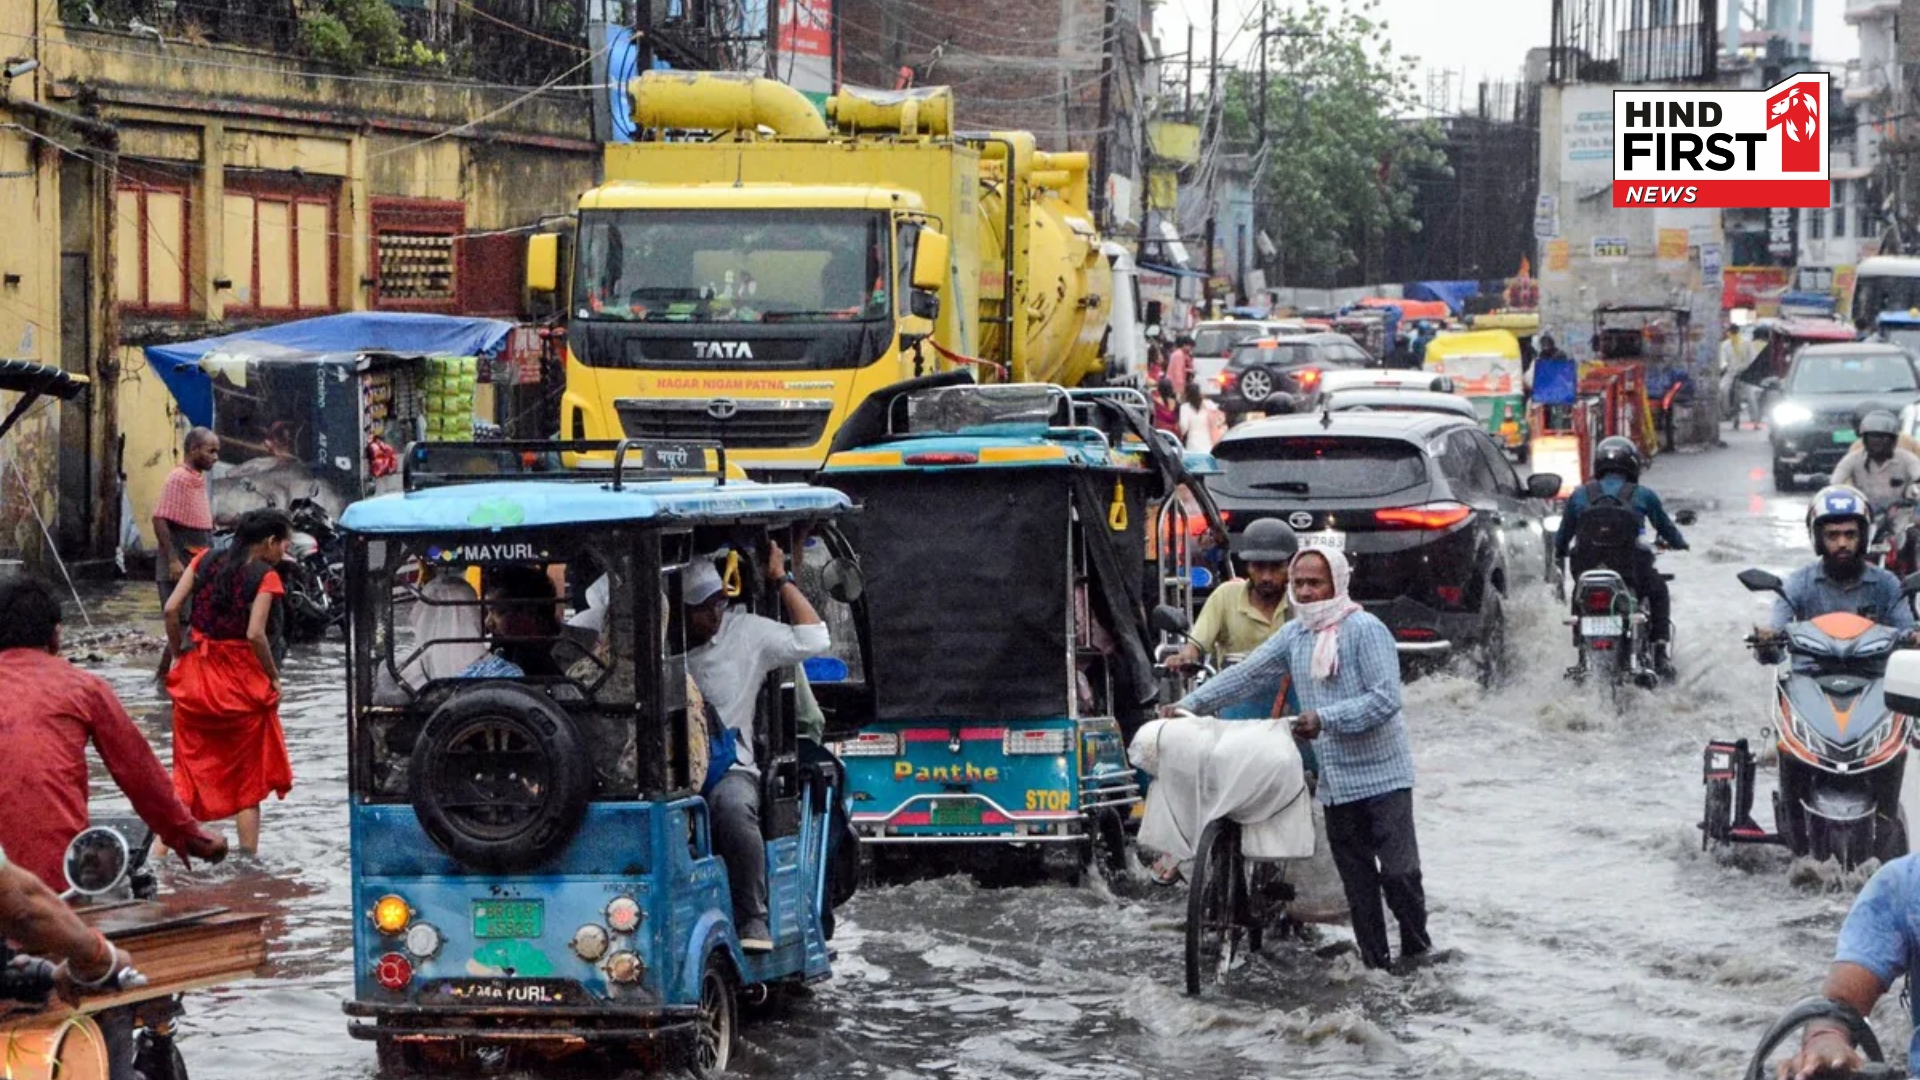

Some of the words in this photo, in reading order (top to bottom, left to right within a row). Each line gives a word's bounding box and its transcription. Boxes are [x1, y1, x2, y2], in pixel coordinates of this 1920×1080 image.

[693, 341, 753, 359] TATA
[657, 378, 699, 390] NAGAR
[702, 379, 743, 390] NIGAM
[745, 380, 785, 391] PATNA
[656, 448, 689, 470] मयूरी
[464, 543, 533, 561] MAYURI
[1025, 789, 1071, 811] STOP
